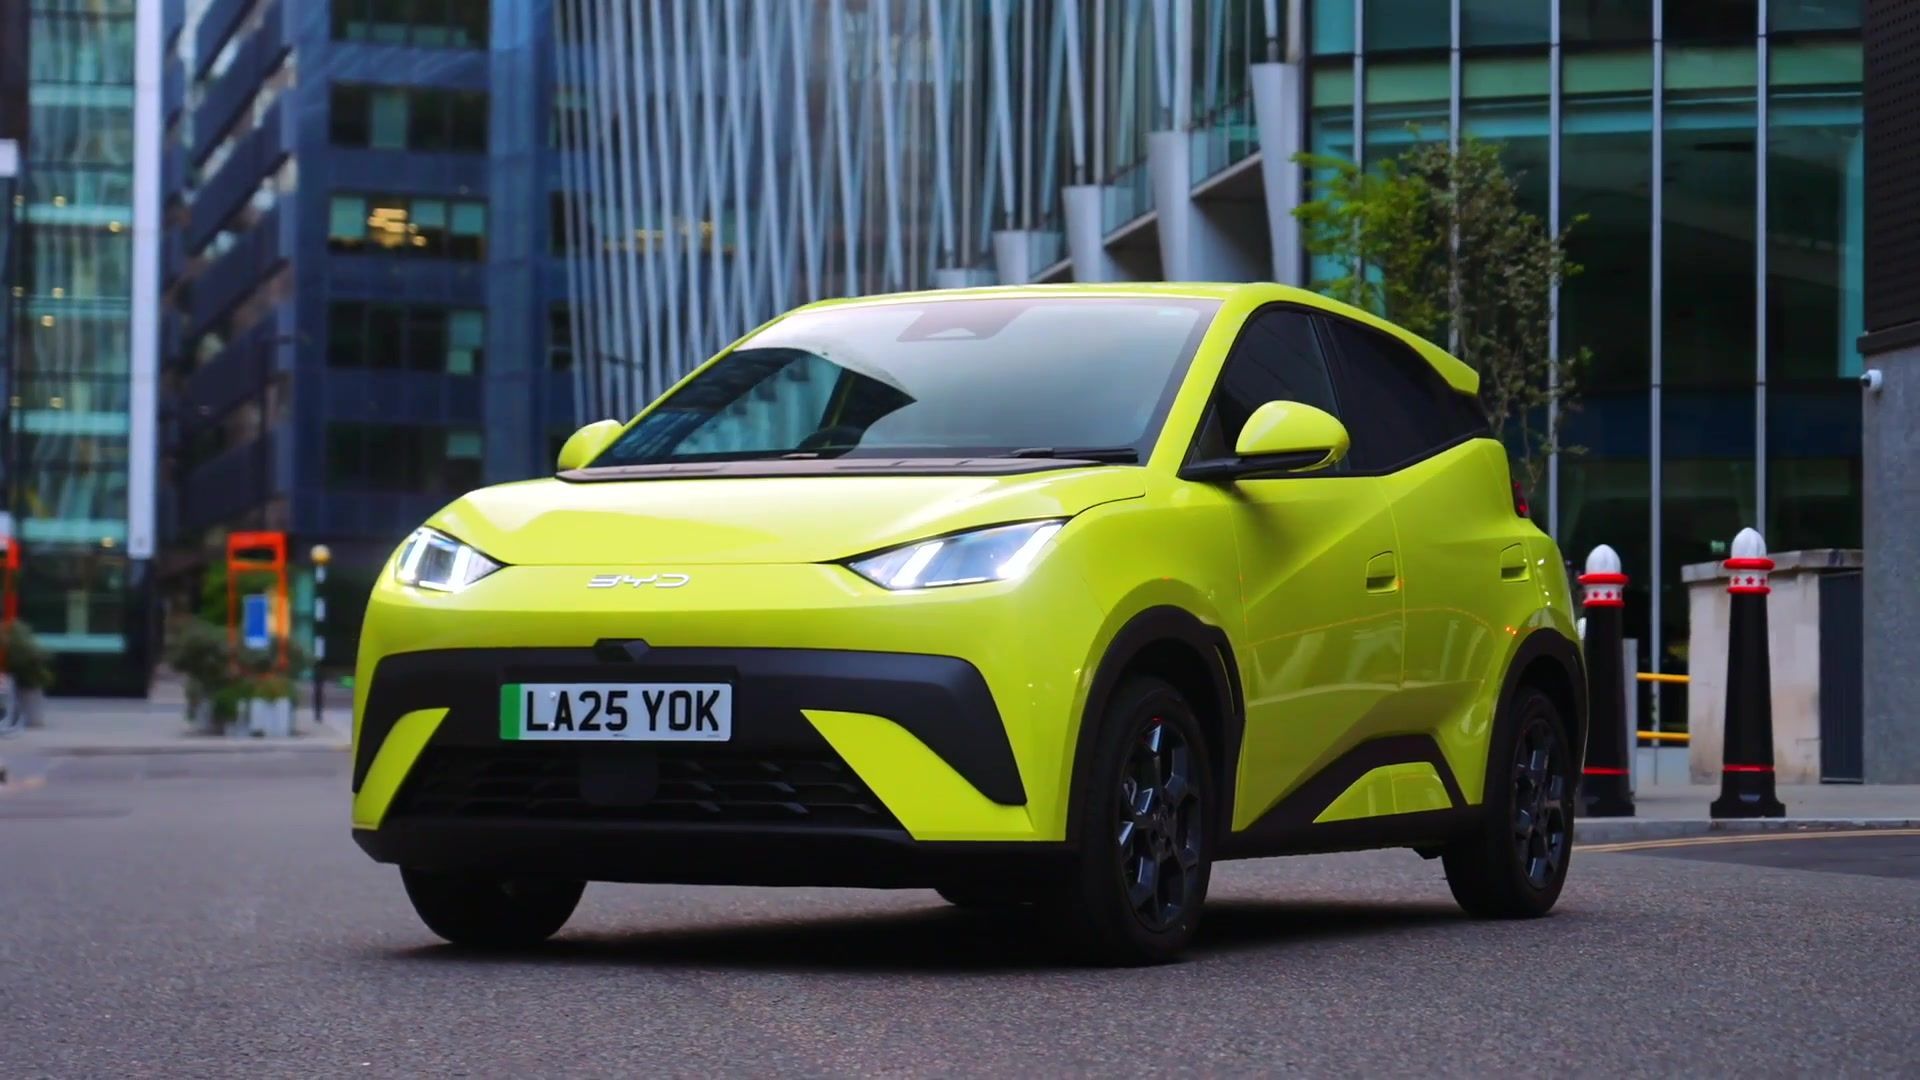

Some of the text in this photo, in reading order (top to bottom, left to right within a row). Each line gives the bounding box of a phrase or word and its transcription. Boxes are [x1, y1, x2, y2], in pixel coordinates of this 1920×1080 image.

[587, 573, 689, 588] BYD
[527, 690, 720, 731] LA25 YOK
